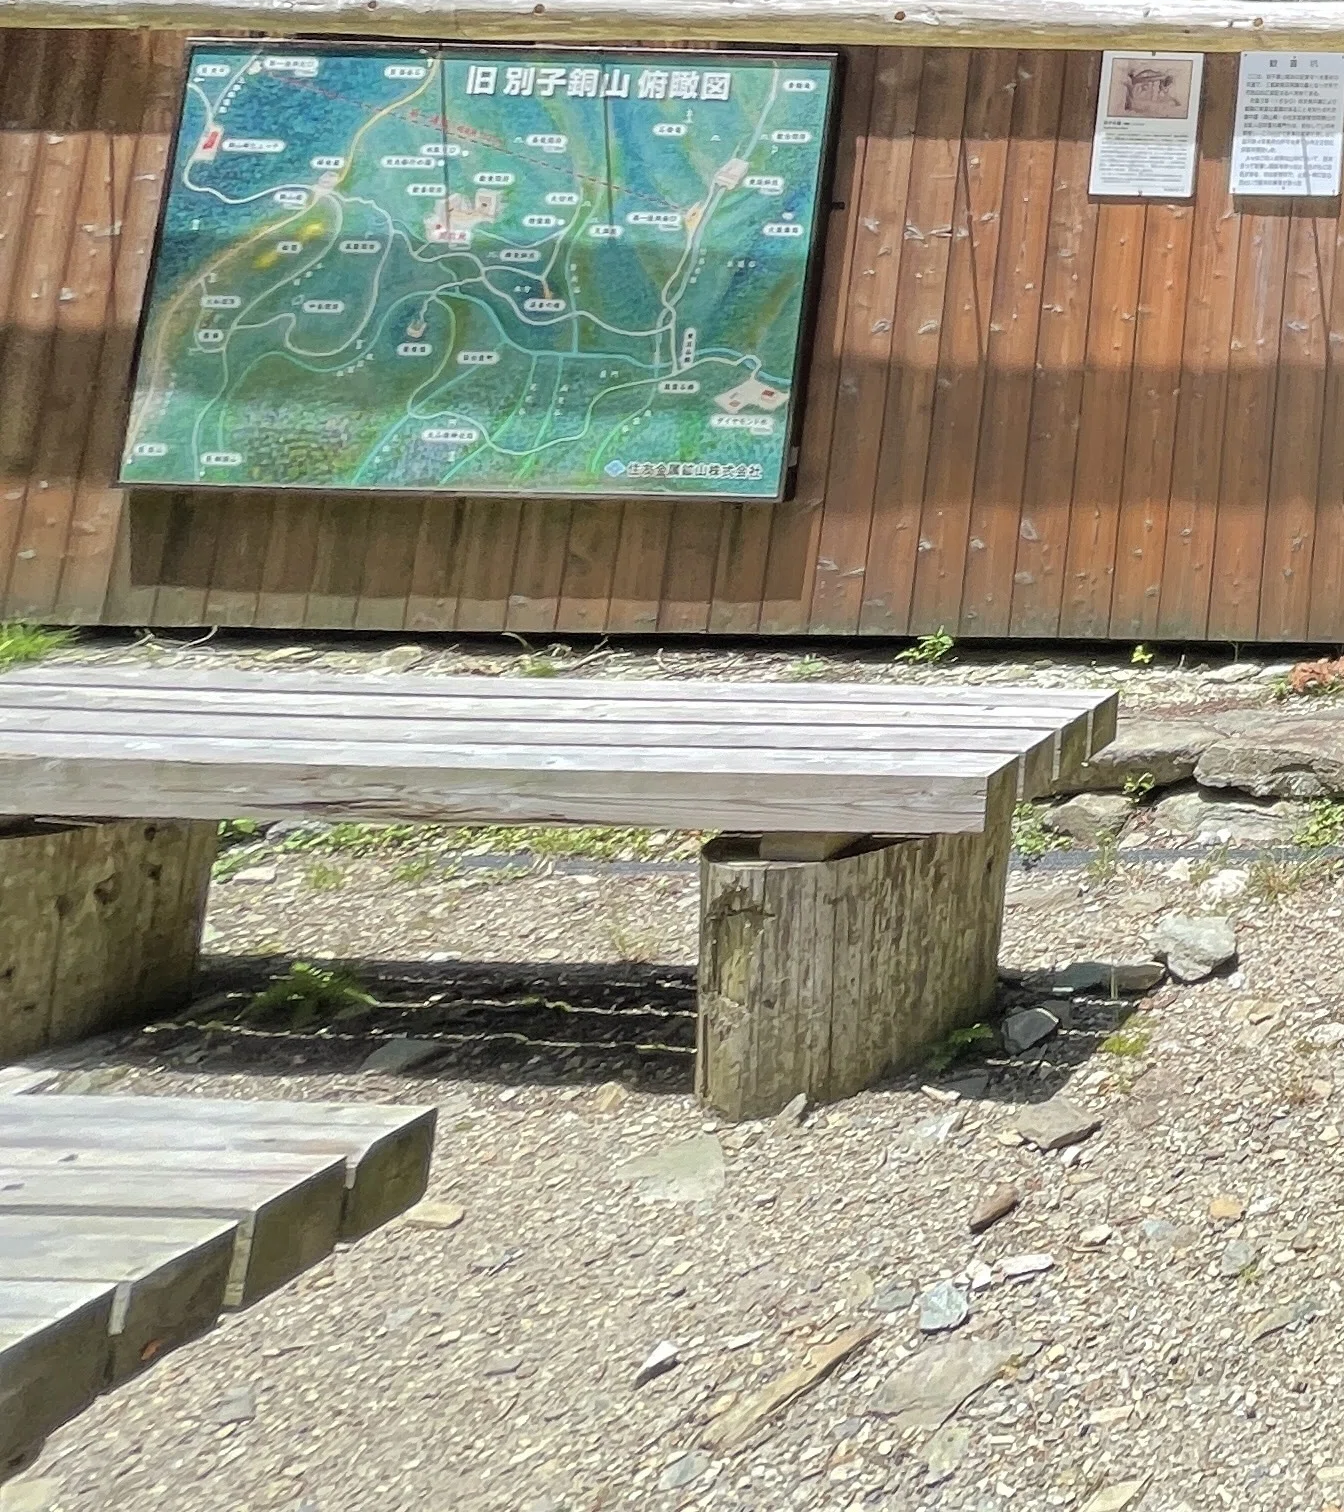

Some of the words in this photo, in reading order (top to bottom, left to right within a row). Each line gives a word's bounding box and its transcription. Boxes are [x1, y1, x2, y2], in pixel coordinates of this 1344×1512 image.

[466, 65, 731, 100] 旧別子銅山俯瞰図
